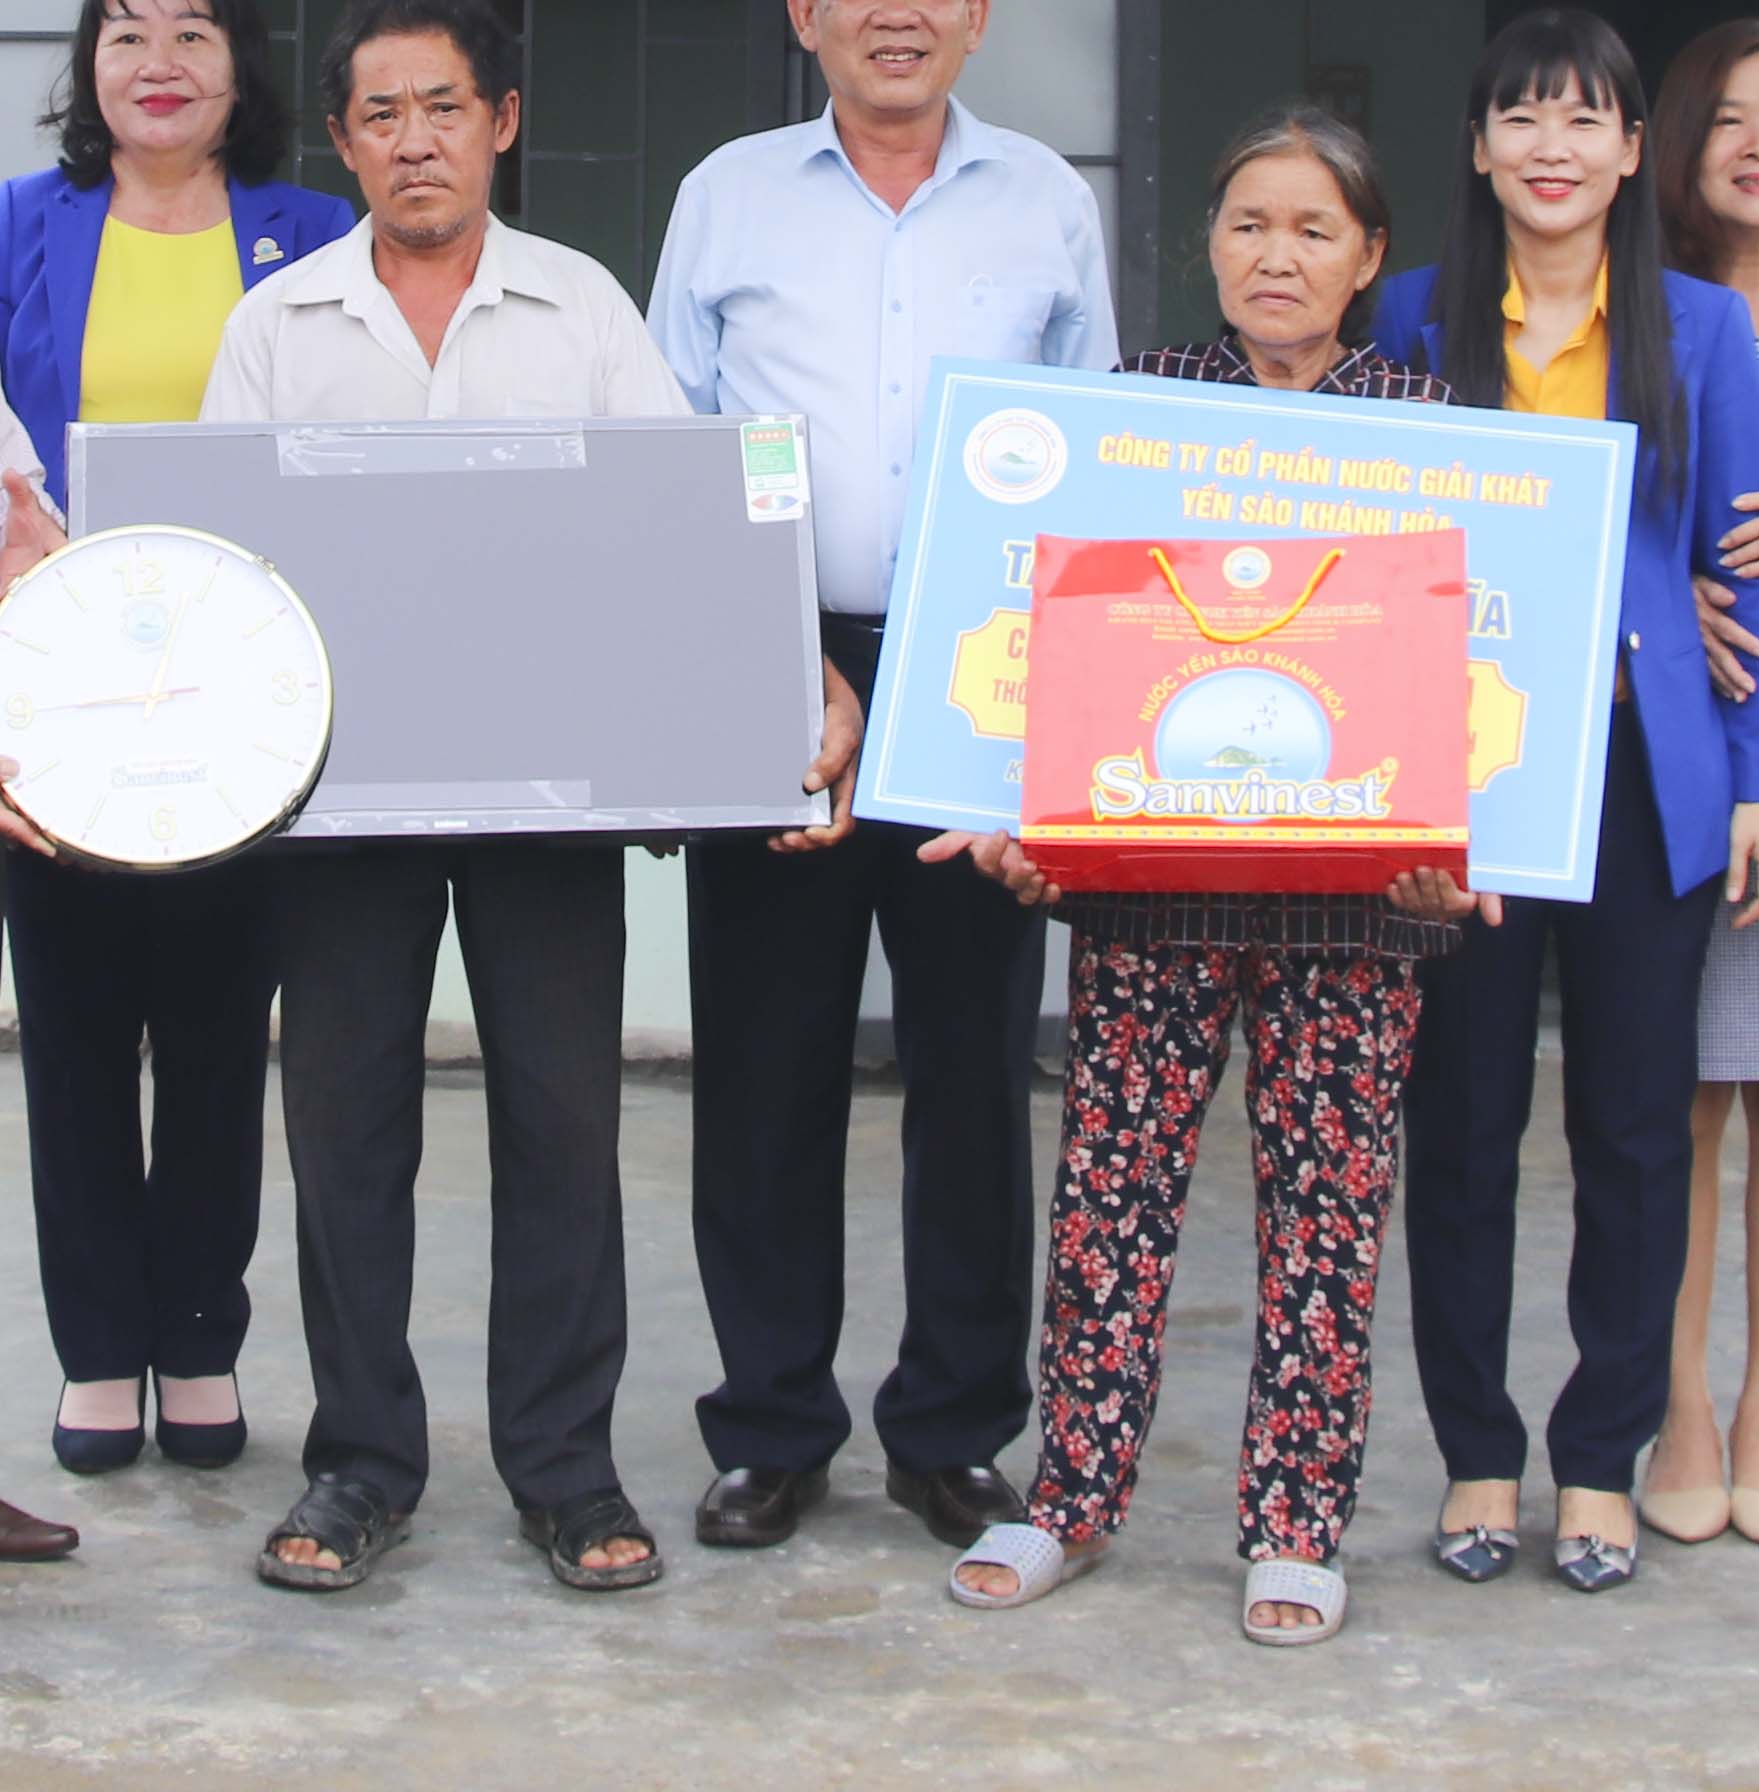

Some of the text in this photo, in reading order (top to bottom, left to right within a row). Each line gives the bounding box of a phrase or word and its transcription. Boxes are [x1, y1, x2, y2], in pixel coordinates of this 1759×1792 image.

[1098, 432, 1171, 469] CÔNG
[1178, 442, 1209, 473] TY
[1214, 437, 1256, 478] CỔ
[1257, 445, 1332, 485] PHẦN
[1338, 456, 1412, 496] NƯỚC
[1418, 461, 1475, 501] GIẢI
[1479, 468, 1551, 508] KHÁT
[1181, 482, 1233, 521] YẾN
[1238, 490, 1293, 528] SÀO
[1299, 499, 1392, 536] KHÁNH
[4, 692, 35, 731] 9
[271, 671, 301, 706] 3
[1090, 746, 1394, 820] Sanvinest
[148, 805, 178, 841] 6
